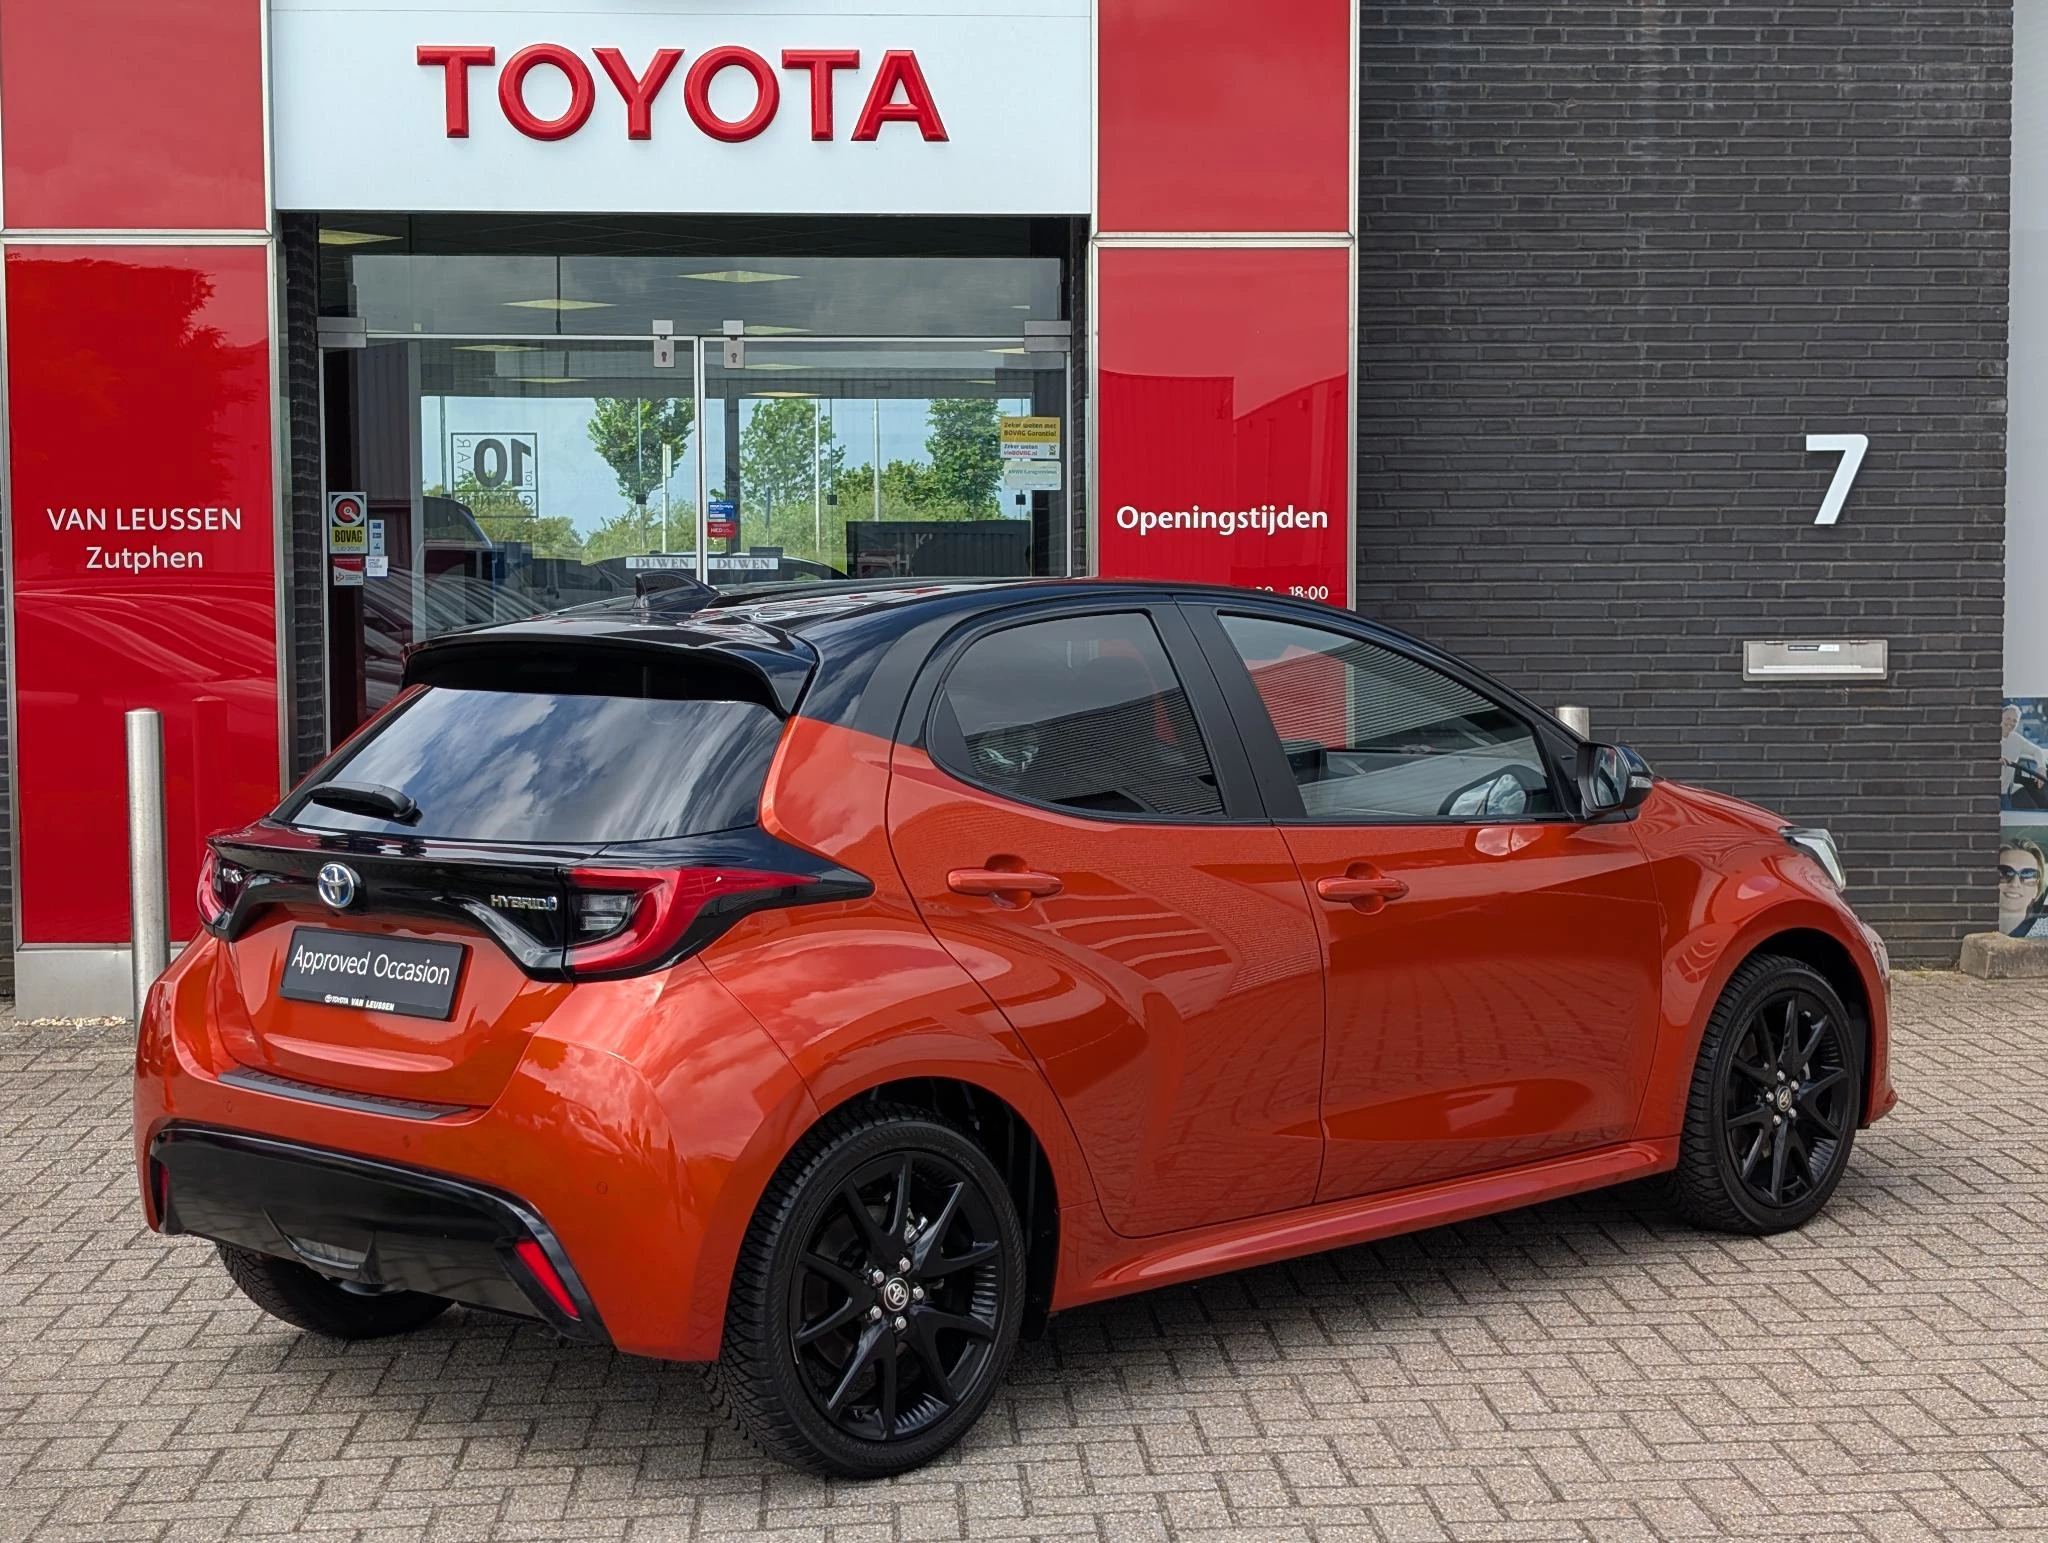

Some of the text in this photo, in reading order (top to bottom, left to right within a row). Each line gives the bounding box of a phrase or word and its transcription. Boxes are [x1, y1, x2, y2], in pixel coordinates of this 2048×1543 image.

[416, 43, 949, 142] TOYOTA
[1805, 433, 1869, 525] 7
[46, 508, 242, 531] VAN LEUSSEN
[1116, 504, 1328, 536] Openingstijden
[334, 529, 363, 543] BOVAG
[86, 545, 203, 575] Zutphen
[635, 558, 689, 568] DUWEN
[716, 559, 770, 569] DUWEN
[1288, 585, 1329, 601] 18:00
[490, 894, 547, 910] HYBRID
[291, 944, 450, 985] Approved Occasion
[351, 997, 365, 1007] VAN
[365, 999, 395, 1011] LEUSSEN
